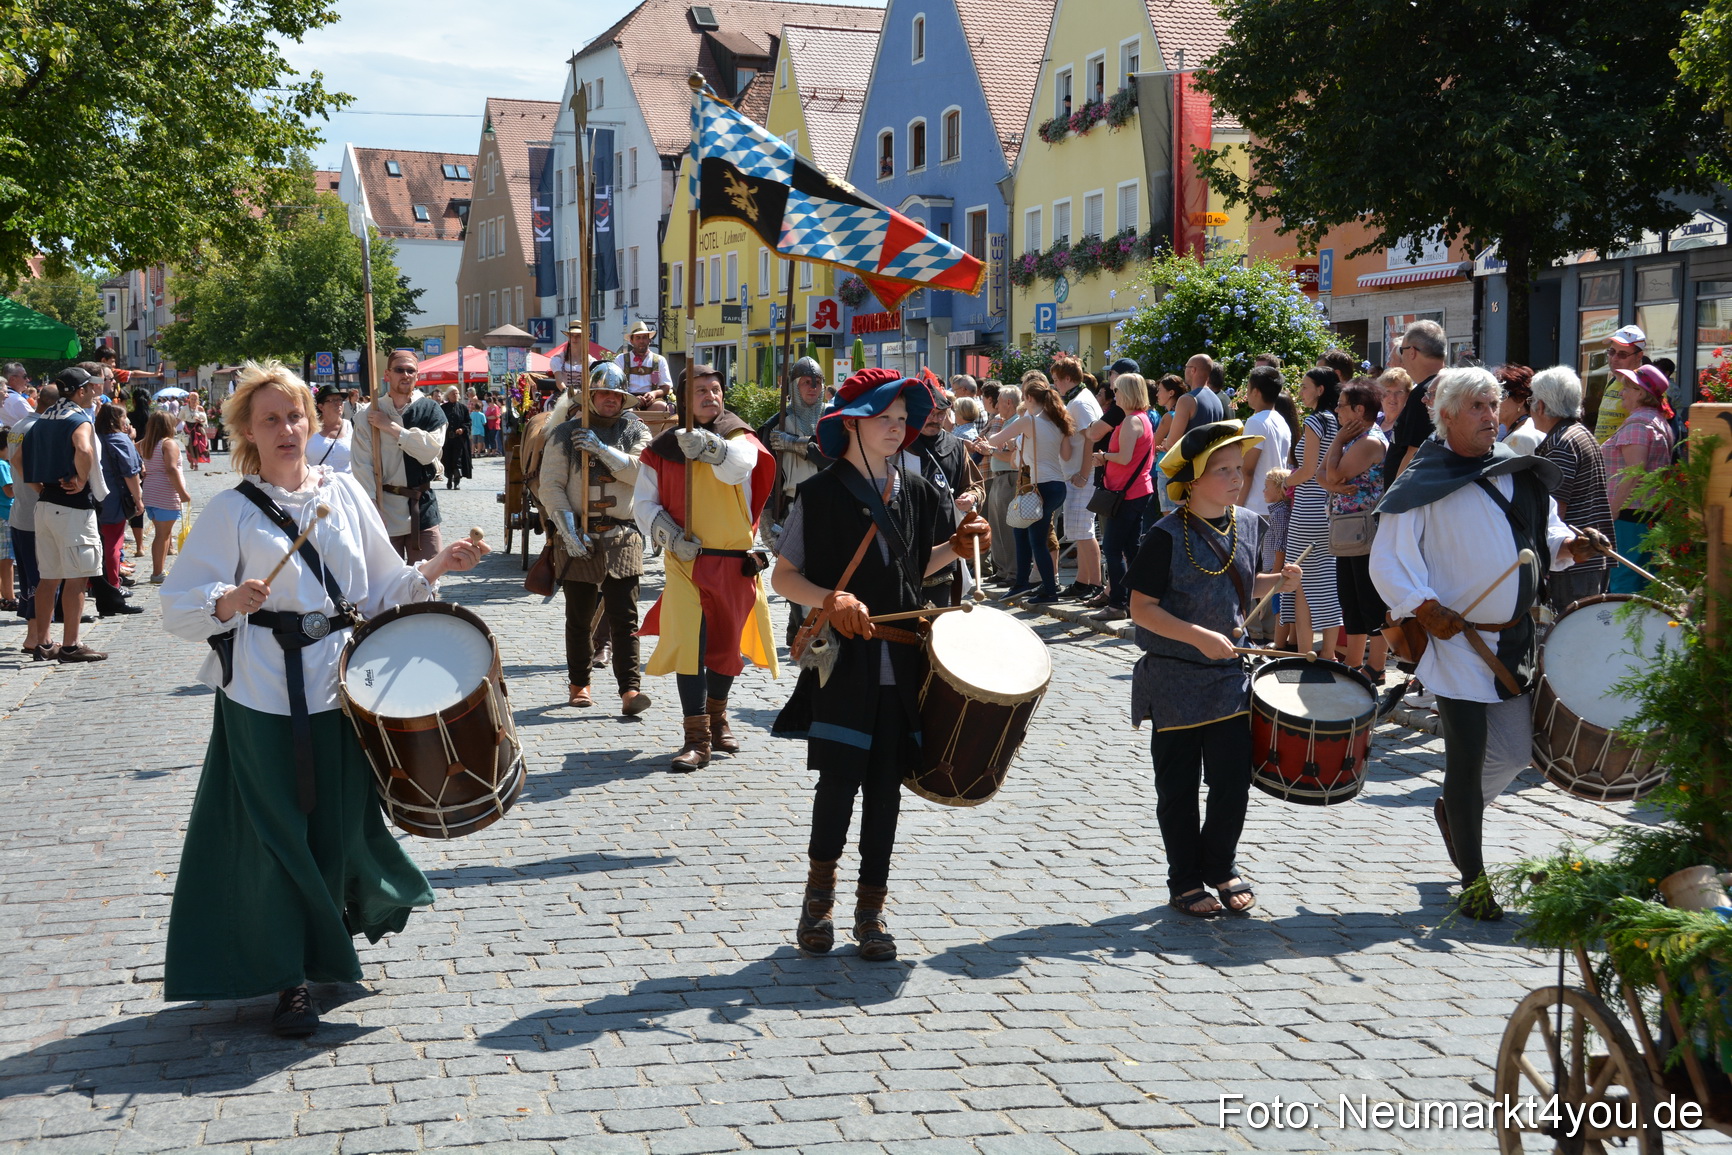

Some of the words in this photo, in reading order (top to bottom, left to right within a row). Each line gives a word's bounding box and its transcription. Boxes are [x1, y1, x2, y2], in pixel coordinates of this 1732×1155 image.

[699, 231, 719, 251] HOTEL
[724, 228, 747, 245] Lehmeier
[850, 310, 901, 334] APOTHEKE
[1040, 306, 1052, 330] P
[697, 324, 726, 338] Restaurant
